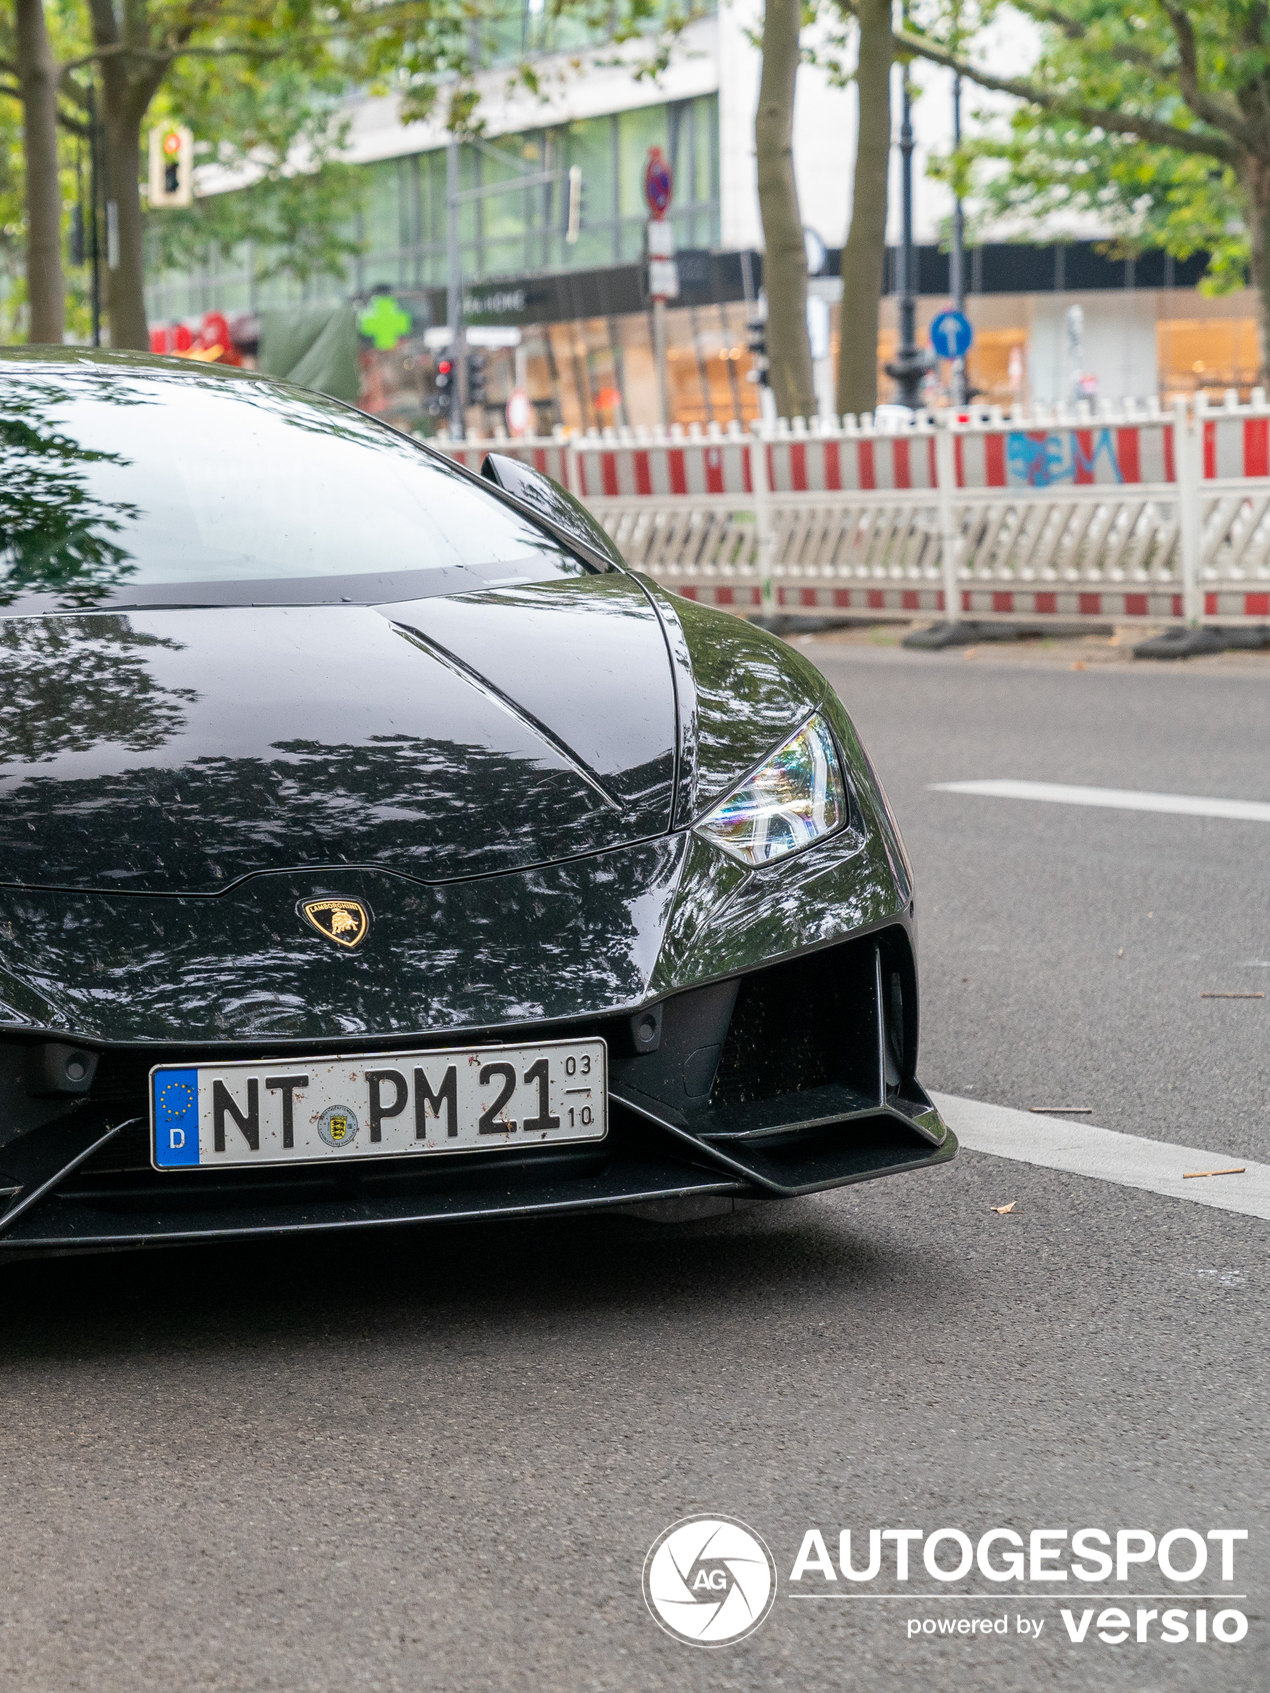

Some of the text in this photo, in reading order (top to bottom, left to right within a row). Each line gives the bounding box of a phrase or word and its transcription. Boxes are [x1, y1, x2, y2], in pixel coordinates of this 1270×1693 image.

[565, 1055, 591, 1076] 03
[213, 1074, 309, 1152] NT
[364, 1065, 458, 1143] PM
[478, 1058, 561, 1135] 21
[568, 1106, 591, 1127] 10
[170, 1128, 185, 1149] D
